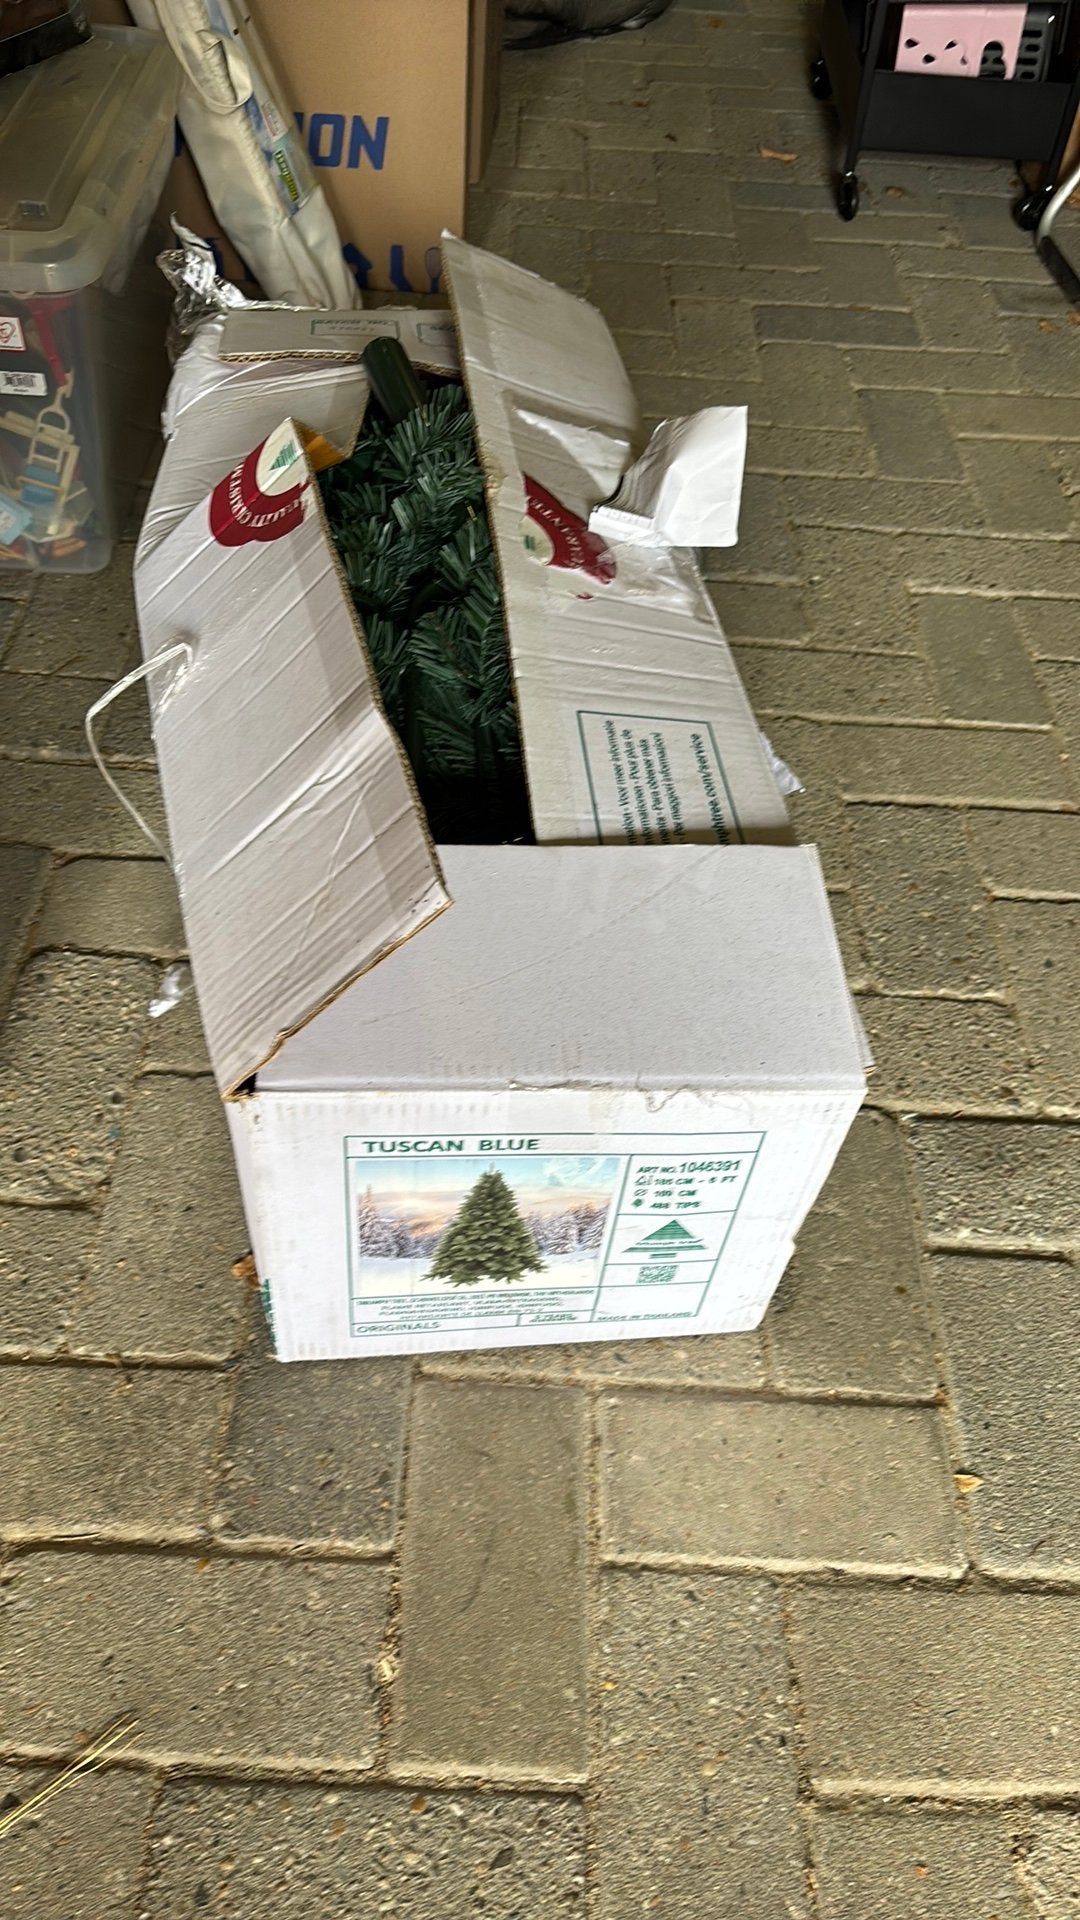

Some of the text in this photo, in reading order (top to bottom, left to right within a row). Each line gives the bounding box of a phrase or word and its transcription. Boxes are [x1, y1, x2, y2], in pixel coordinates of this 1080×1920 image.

[613, 763, 625, 784] meer
[628, 760, 640, 779] Pour
[617, 786, 629, 807] Voor
[651, 791, 664, 811] Para
[362, 1139, 540, 1153] TUSCAN BLUE
[356, 1321, 441, 1333] ORIGINALS
